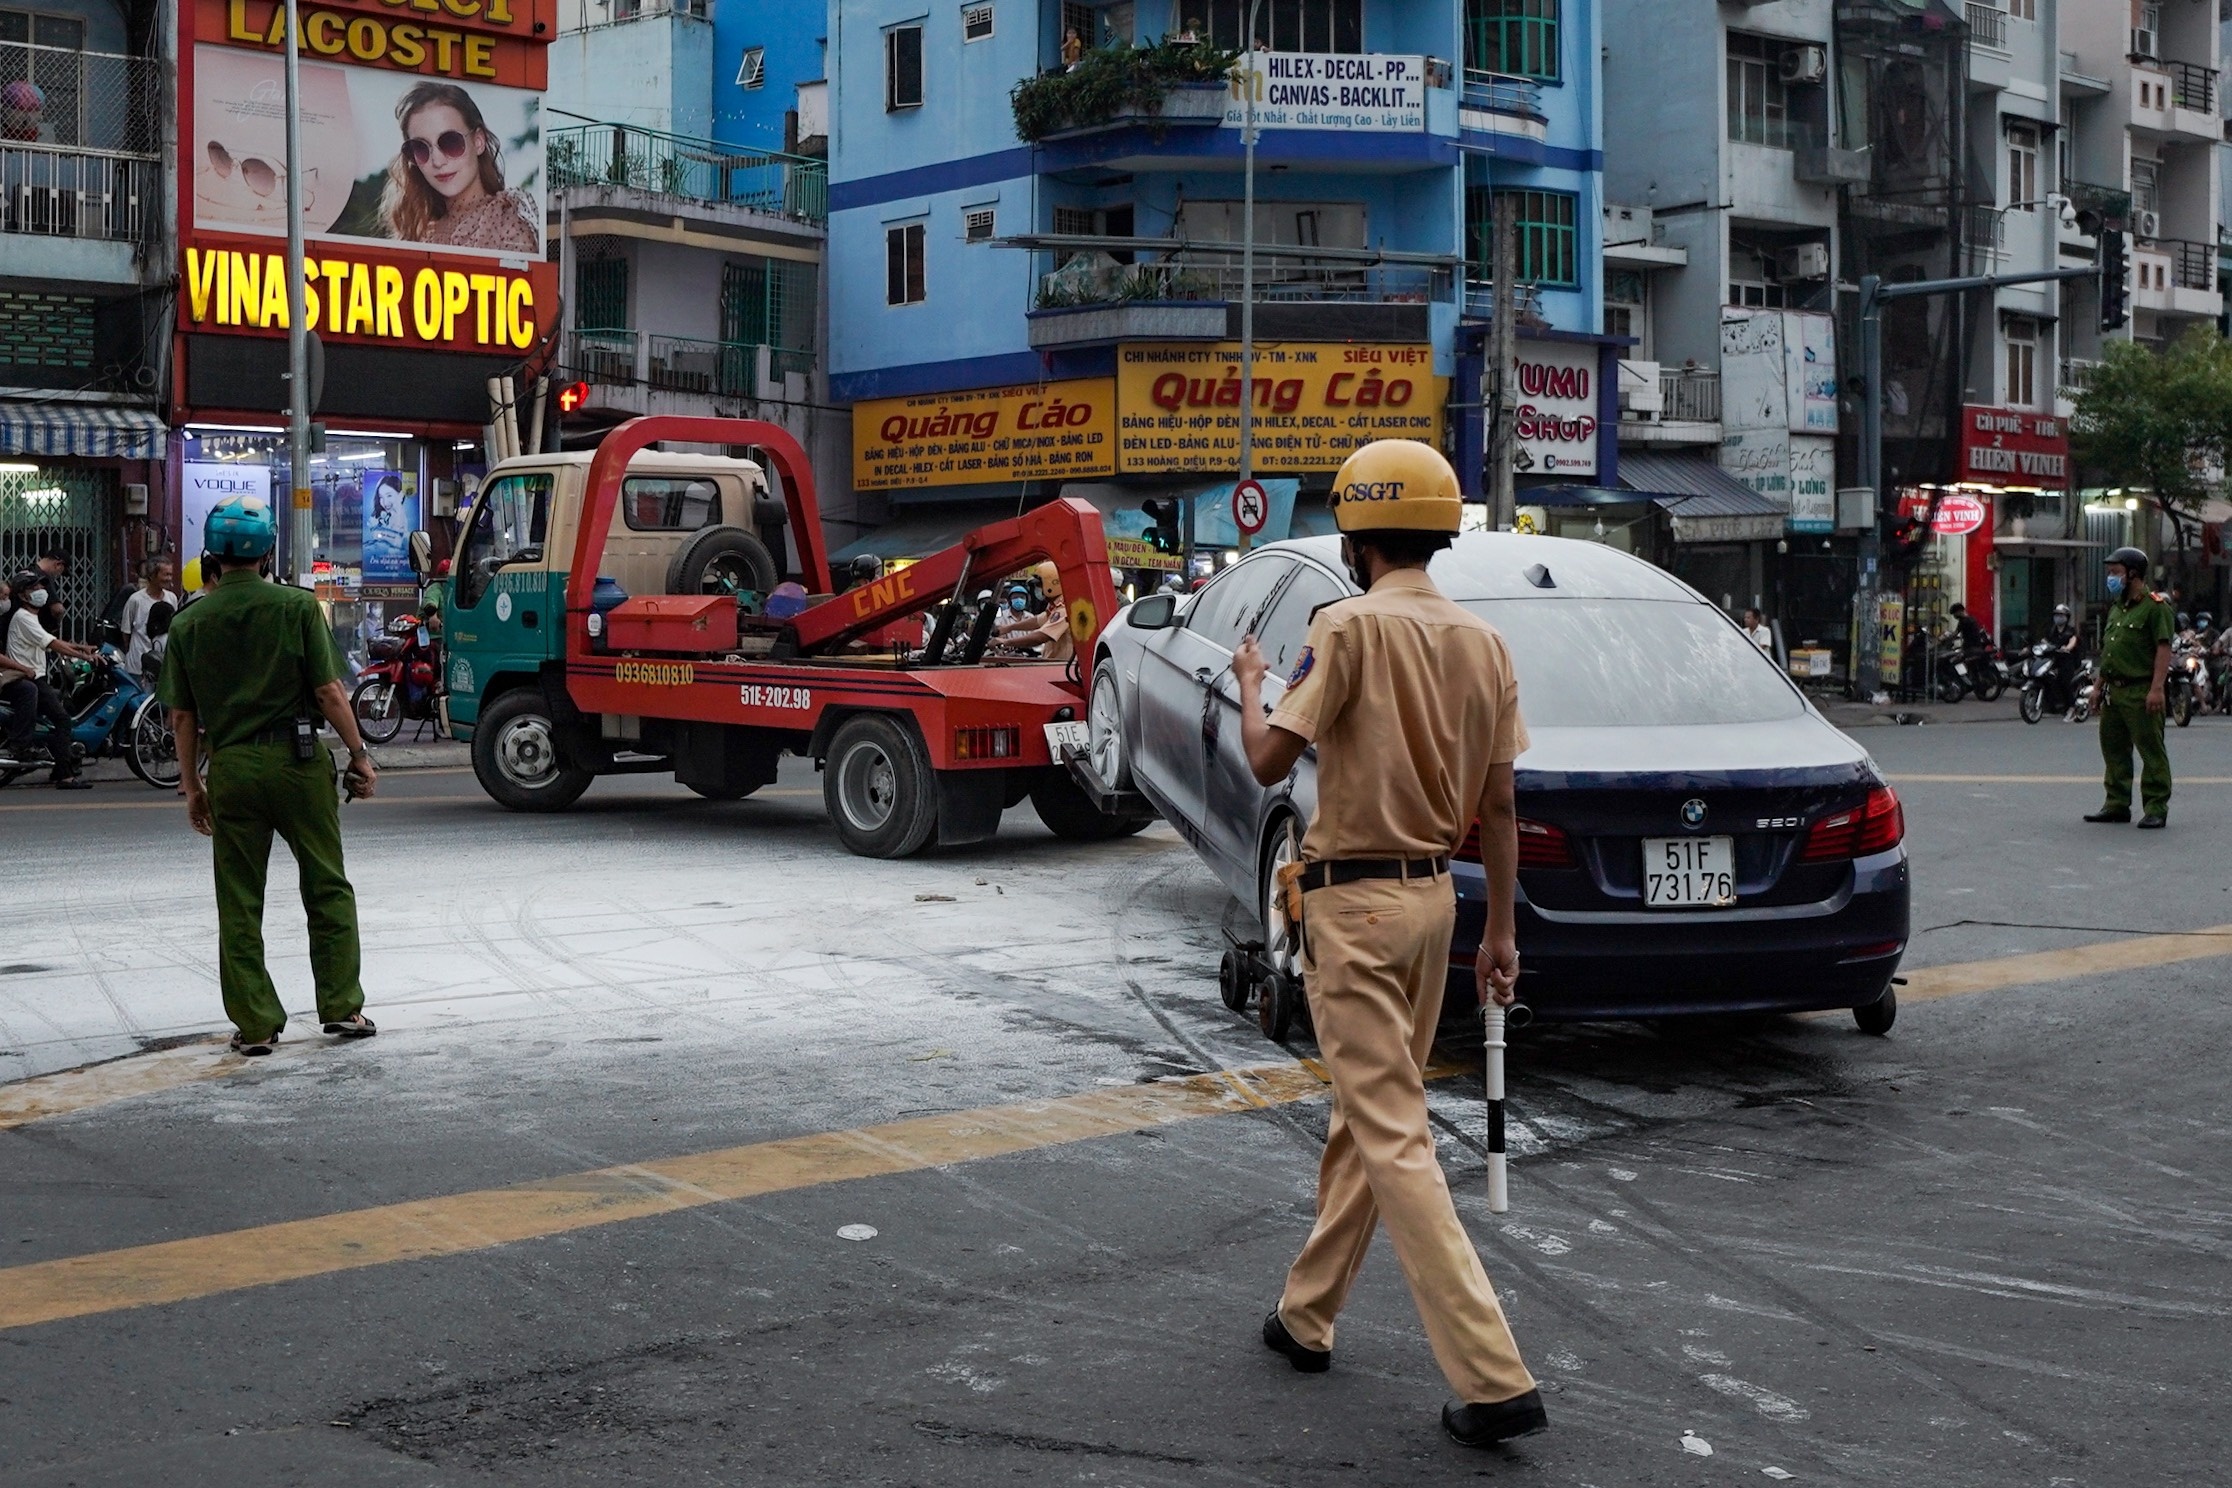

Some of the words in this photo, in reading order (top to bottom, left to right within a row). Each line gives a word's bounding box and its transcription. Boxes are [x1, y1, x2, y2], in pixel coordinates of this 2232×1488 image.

[229, 0, 497, 78] LACOSTE
[1268, 57, 1315, 79] HILEX
[1325, 59, 1375, 81] DECAL
[1268, 84, 1330, 106] CANVAS
[1226, 109, 1242, 123] Giá
[1264, 107, 1287, 124] Nhất
[1296, 105, 1319, 125] Chất
[1321, 112, 1351, 127] Lượng
[1354, 113, 1373, 126] Cao
[185, 247, 405, 338] VINASTAR
[413, 267, 535, 349] OPTIC
[1124, 351, 1144, 363] CHI
[1147, 348, 1185, 363] NHÁNH
[1188, 351, 1210, 363] CTY
[1215, 351, 1243, 363] TNHH
[1269, 351, 1286, 363] TM
[1295, 351, 1318, 363] XNK
[1344, 347, 1382, 364] SIÊU
[1389, 346, 1428, 367] VIỆT
[1152, 365, 1304, 414] Quảng
[1324, 367, 1413, 408] Cáo
[1513, 356, 1590, 399] UMI
[880, 407, 999, 444] Quảng
[1016, 398, 1093, 431] Cáo
[1122, 412, 1154, 428] BẢNG
[1158, 414, 1183, 431] HIỆU
[1189, 415, 1213, 431] HỘP
[1216, 413, 1240, 429] ĐÈN
[1301, 416, 1337, 428] DECAL
[1348, 411, 1370, 428] CẮT
[1372, 416, 1407, 429] LASER
[1410, 416, 1431, 429] CNC
[1516, 404, 1597, 441] SHOP
[1087, 433, 1103, 444] LED
[1123, 434, 1147, 449] ĐÈN
[1150, 438, 1172, 449] LED
[1178, 433, 1209, 449] BẢNG
[1213, 437, 1235, 449] ALU
[1251, 434, 1273, 449] ẢNG
[1275, 435, 1301, 451] ĐIỆN
[874, 465, 882, 476] IN
[884, 463, 908, 476] DECAL
[957, 458, 982, 471] LASER
[1075, 451, 1093, 463] RON
[1126, 457, 1145, 466] 133
[1147, 454, 1180, 466] HOÀNG
[2017, 451, 2066, 477] VINH
[856, 479, 870, 488] 133
[1343, 482, 1404, 502] CSGT
[1952, 508, 1979, 522] VINH
[853, 570, 916, 618] CNC
[615, 662, 694, 686] 0936810810
[740, 684, 811, 710] 51E-202.98
[1055, 725, 1081, 743] 51E
[1666, 842, 1711, 871] 51F
[1649, 872, 1732, 902] 731.76
